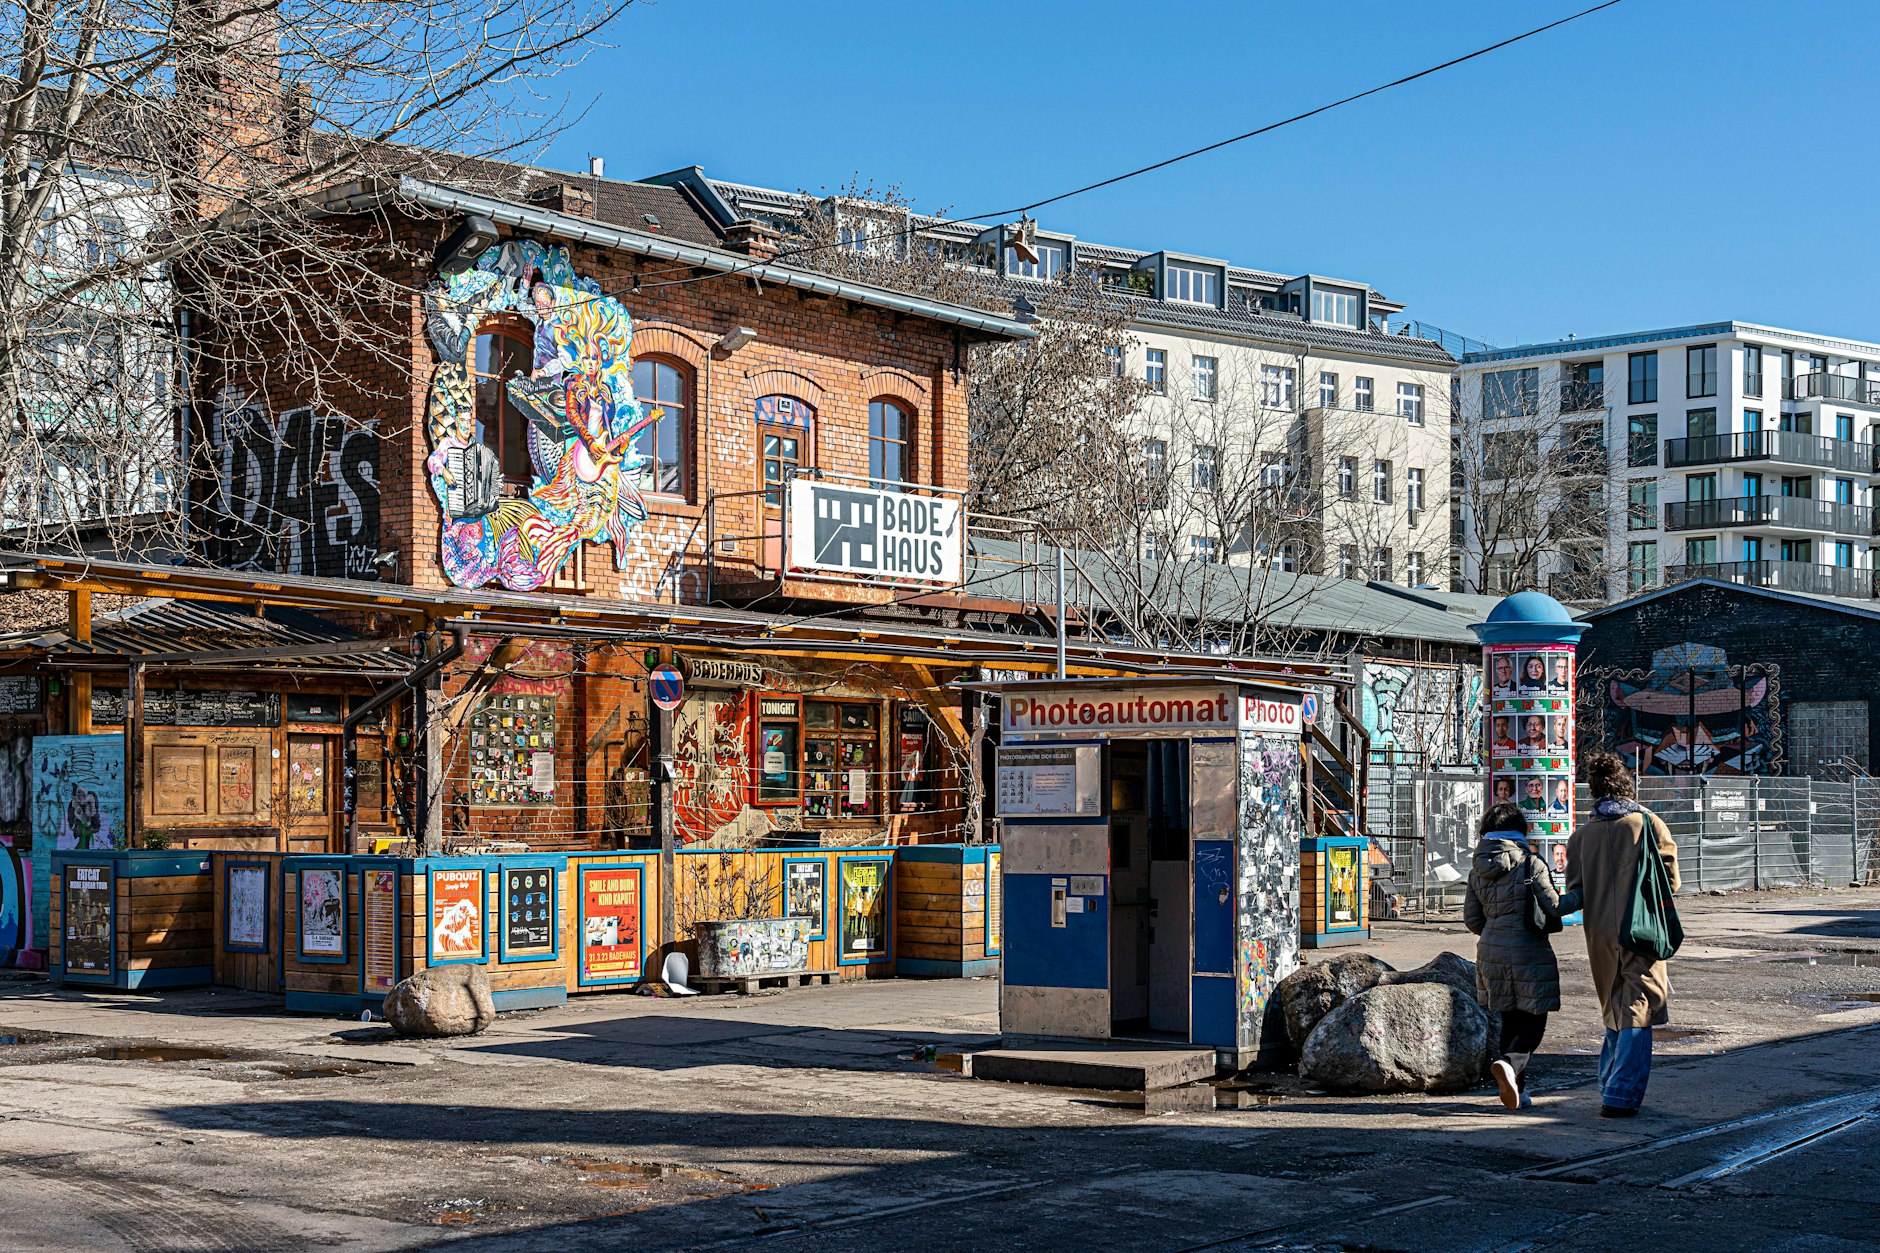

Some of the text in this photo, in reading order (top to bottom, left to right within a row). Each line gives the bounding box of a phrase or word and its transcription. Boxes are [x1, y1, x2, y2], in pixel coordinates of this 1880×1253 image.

[883, 495, 943, 537] BADE
[883, 535, 943, 576] HAUS
[693, 660, 761, 681] BADEHAUS
[762, 702, 796, 715] TONIGHT
[1009, 692, 1229, 726] Photoautomat
[1245, 694, 1295, 725] Photo
[1522, 700, 1534, 710] Ja!
[1551, 700, 1562, 709] Ja!
[1521, 758, 1534, 768] Ja!
[1551, 758, 1561, 768] Ja!
[1035, 803, 1040, 812] 4
[1551, 822, 1561, 832] Ja!
[77, 868, 100, 881] FATCAT
[436, 872, 478, 881] PUBQUIZ
[96, 882, 108, 890] TOUR
[590, 878, 634, 892] SMILE AND BURN
[599, 893, 612, 906] KIND
[613, 892, 635, 905] KAPUTT
[589, 951, 636, 962] 31.3.23 BADEHAUS
